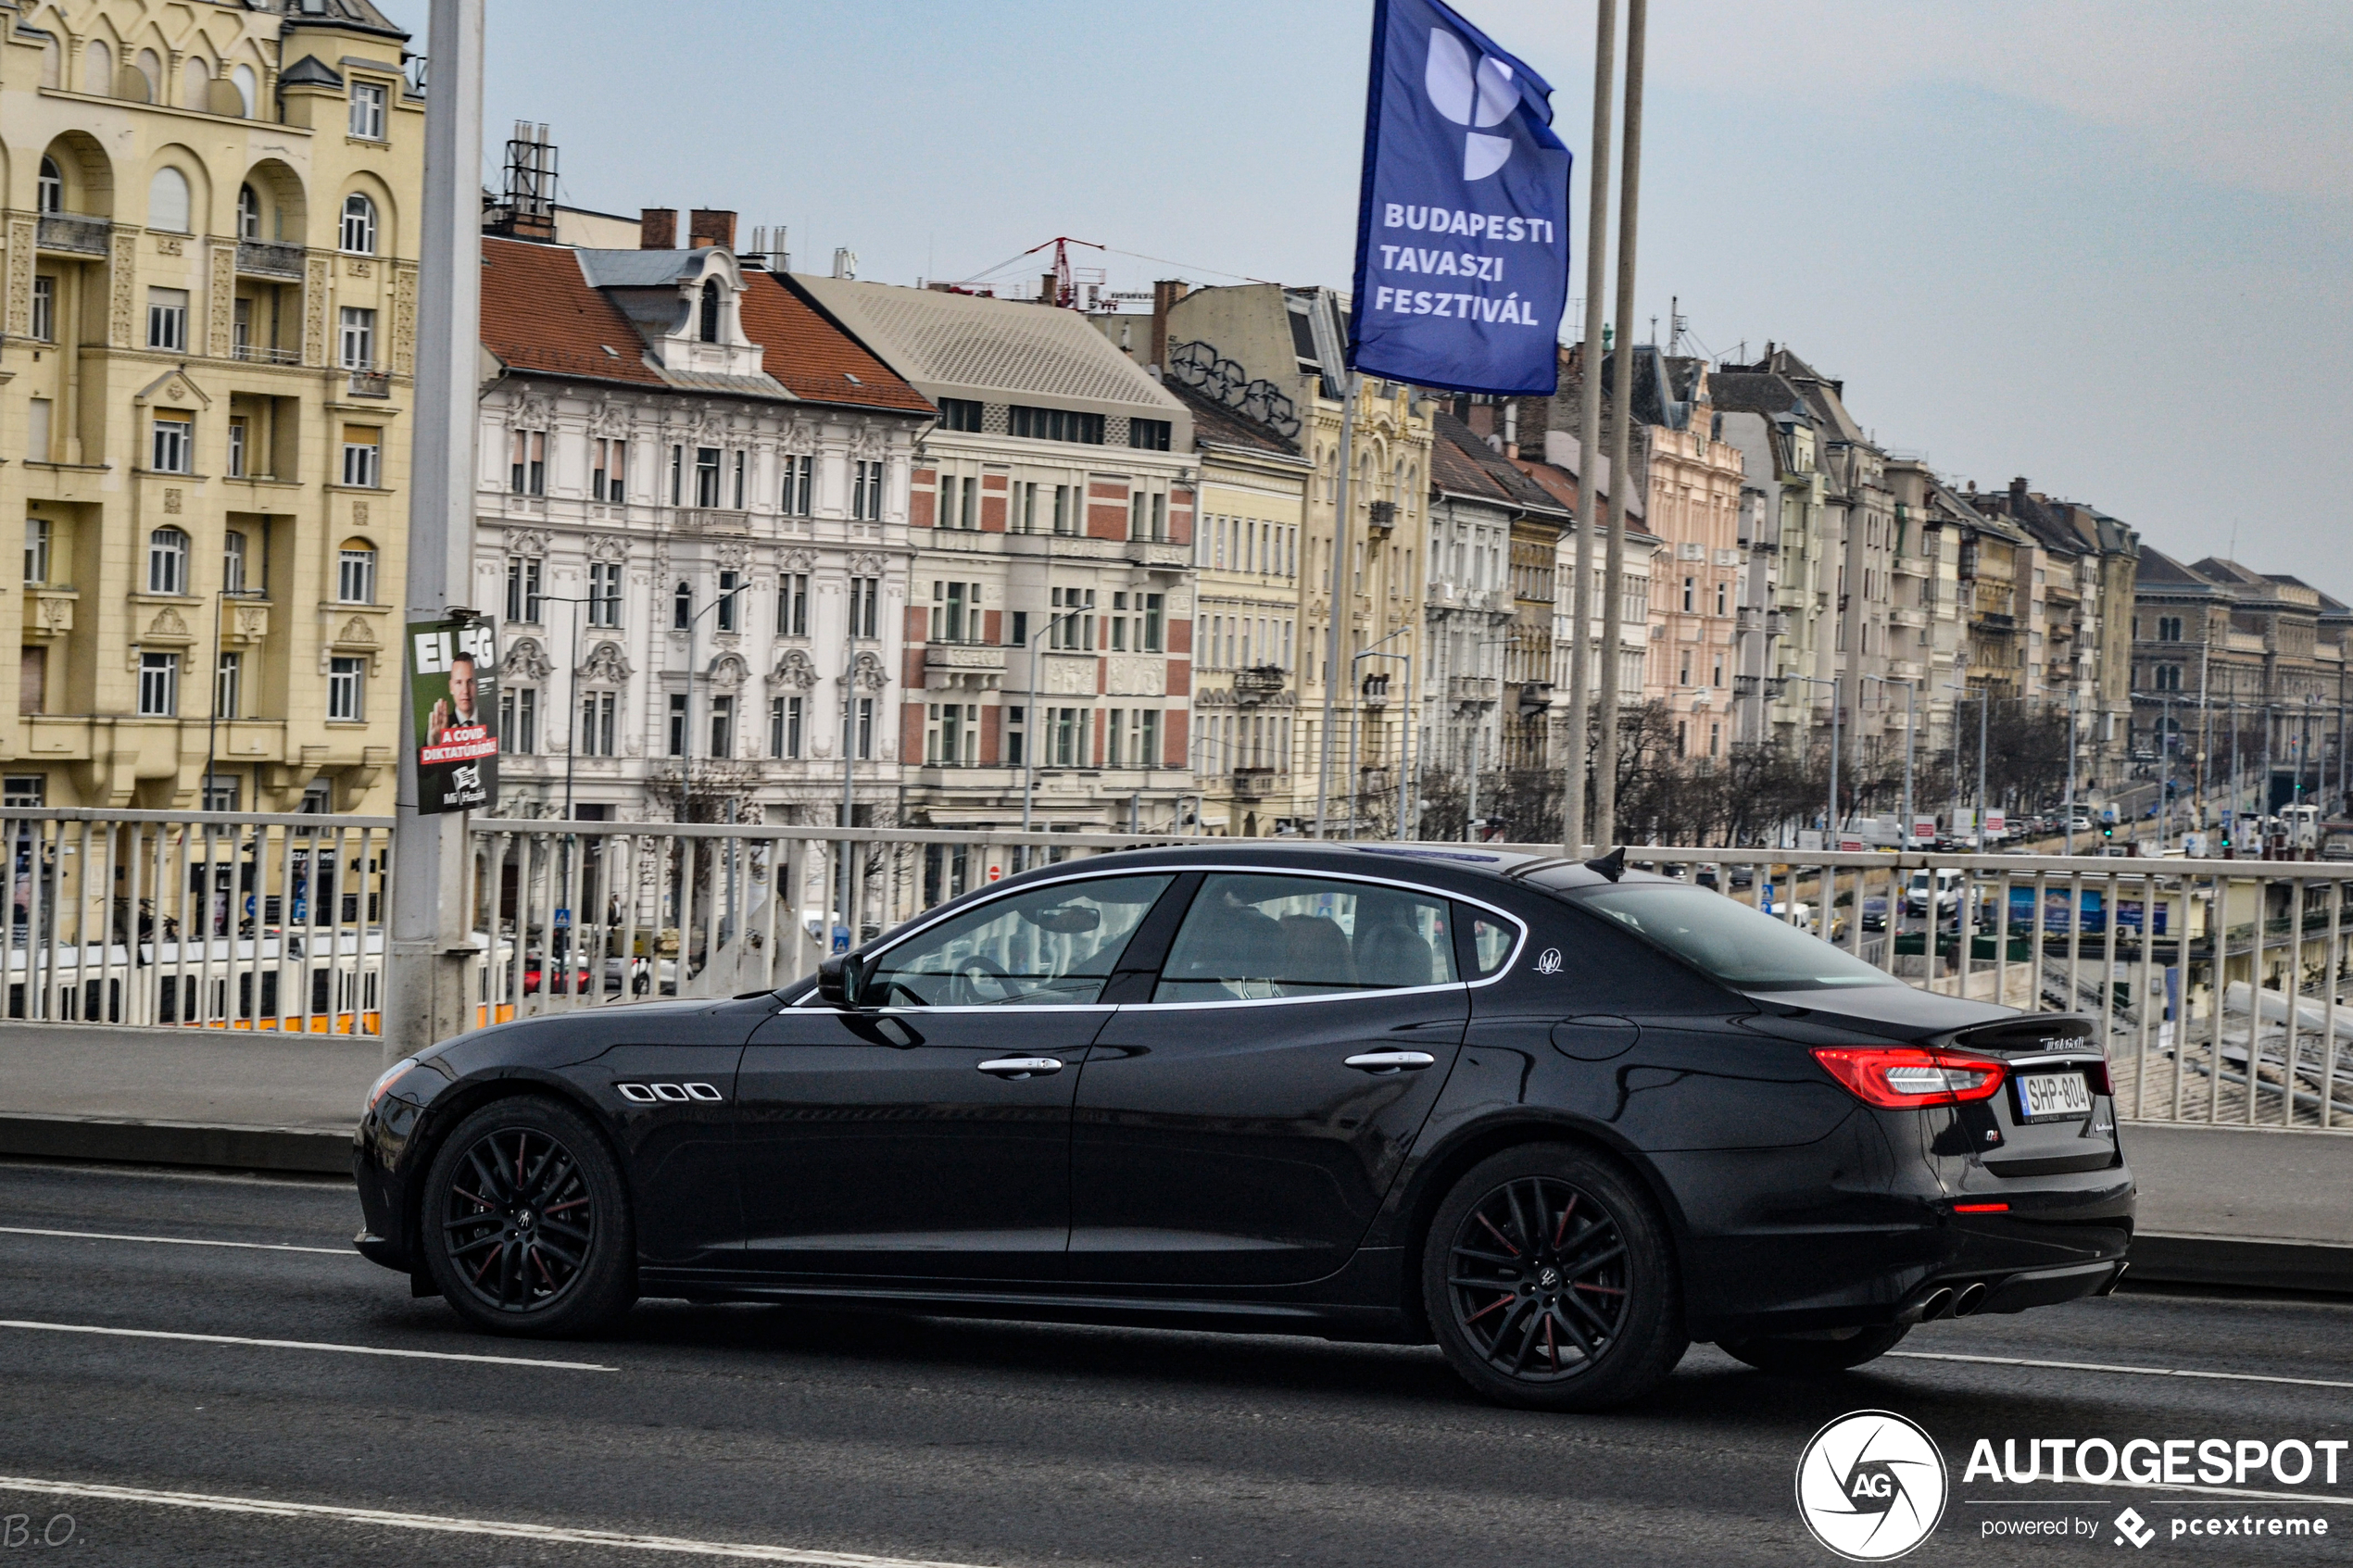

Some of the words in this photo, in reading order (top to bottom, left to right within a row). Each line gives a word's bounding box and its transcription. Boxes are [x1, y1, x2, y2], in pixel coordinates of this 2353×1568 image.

[1384, 203, 1554, 244] BUDAPESTI
[1379, 245, 1504, 282] TAVASZI
[1375, 286, 1539, 326] FESZTIVÁL
[414, 619, 495, 674] ELÉG
[442, 731, 453, 743] A
[2021, 1099, 2029, 1110] H
[2028, 1076, 2087, 1111] SHP-804
